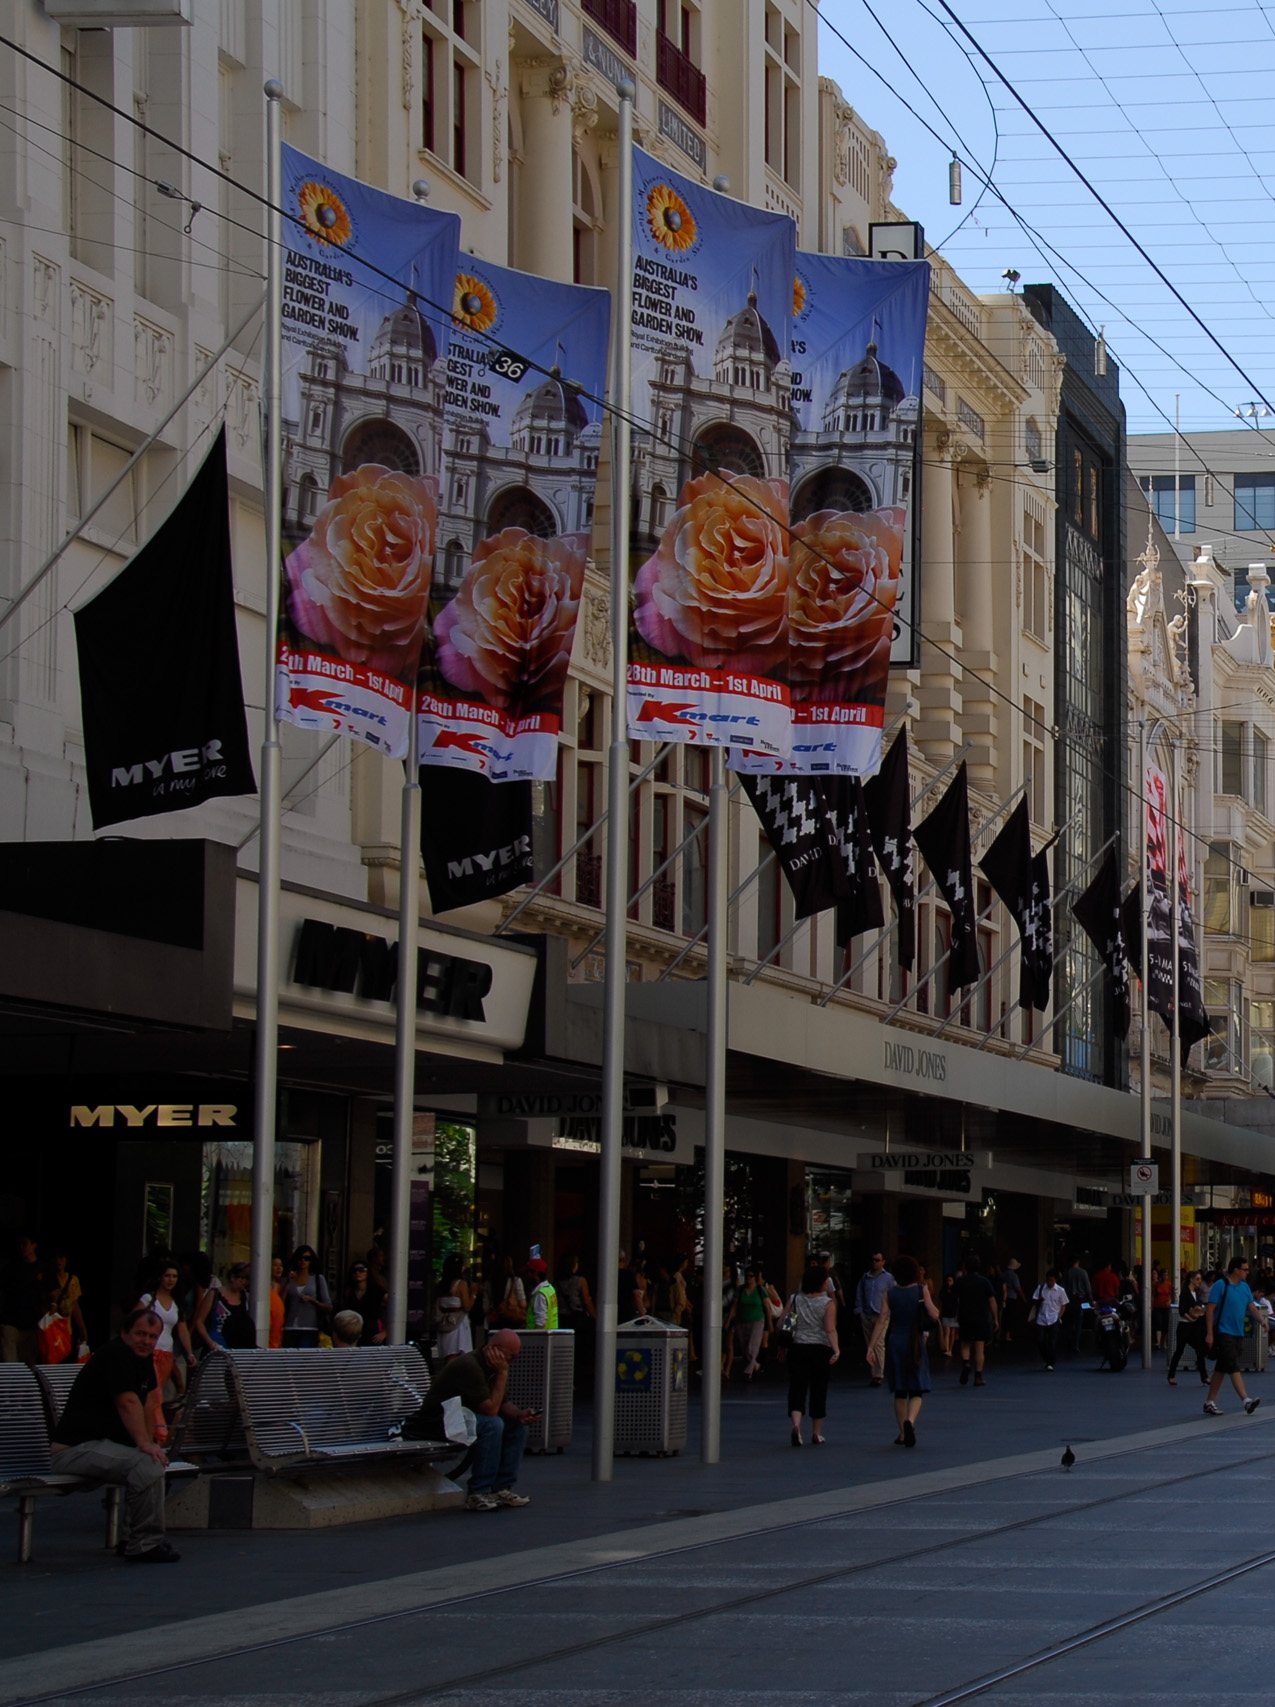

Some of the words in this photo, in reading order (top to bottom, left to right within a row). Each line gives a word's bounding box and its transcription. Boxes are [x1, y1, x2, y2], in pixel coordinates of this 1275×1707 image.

[600, 47, 630, 83] NUN
[661, 103, 702, 162] LIMITED
[286, 250, 352, 287] AUSTRALIA'S
[318, 249, 345, 260] Garden
[665, 252, 690, 264] Garden
[286, 267, 332, 296] BIGGEST
[632, 272, 678, 301] BIGGEST
[634, 254, 698, 291] AUSTRALIA'S
[284, 285, 326, 314] FLOWER
[327, 301, 350, 320] AND
[632, 291, 672, 318] FLOWER
[674, 305, 696, 324] AND
[282, 302, 326, 331] GARDEN
[327, 318, 360, 342] SHOW.
[631, 309, 673, 336] GARDEN
[675, 323, 704, 346] SHOW.
[496, 356, 524, 378] 36
[470, 382, 491, 400] AND
[470, 398, 502, 418] SHOW.
[308, 655, 354, 681] March
[367, 672, 382, 692] 1st
[384, 678, 404, 702] April
[660, 669, 710, 689] March
[726, 676, 748, 693] 1st
[750, 682, 782, 700] April
[288, 687, 388, 727] Kmart
[422, 695, 452, 718] 28th
[456, 702, 500, 725] March
[636, 700, 760, 726] Kmart
[810, 706, 829, 722] 1st
[831, 706, 866, 722] April
[112, 738, 224, 788] MYER
[170, 778, 196, 796] my
[447, 834, 532, 880] MYER
[788, 846, 823, 872] DAVID
[293, 918, 494, 1023] MYER
[884, 1040, 914, 1075] DAVID
[915, 1047, 946, 1083] JONES
[70, 1104, 238, 1128] MYER
[498, 1094, 562, 1114] DAVID
[872, 1154, 919, 1168] DAVID
[923, 1153, 974, 1168] JONES
[1113, 1194, 1141, 1205] DAVI
